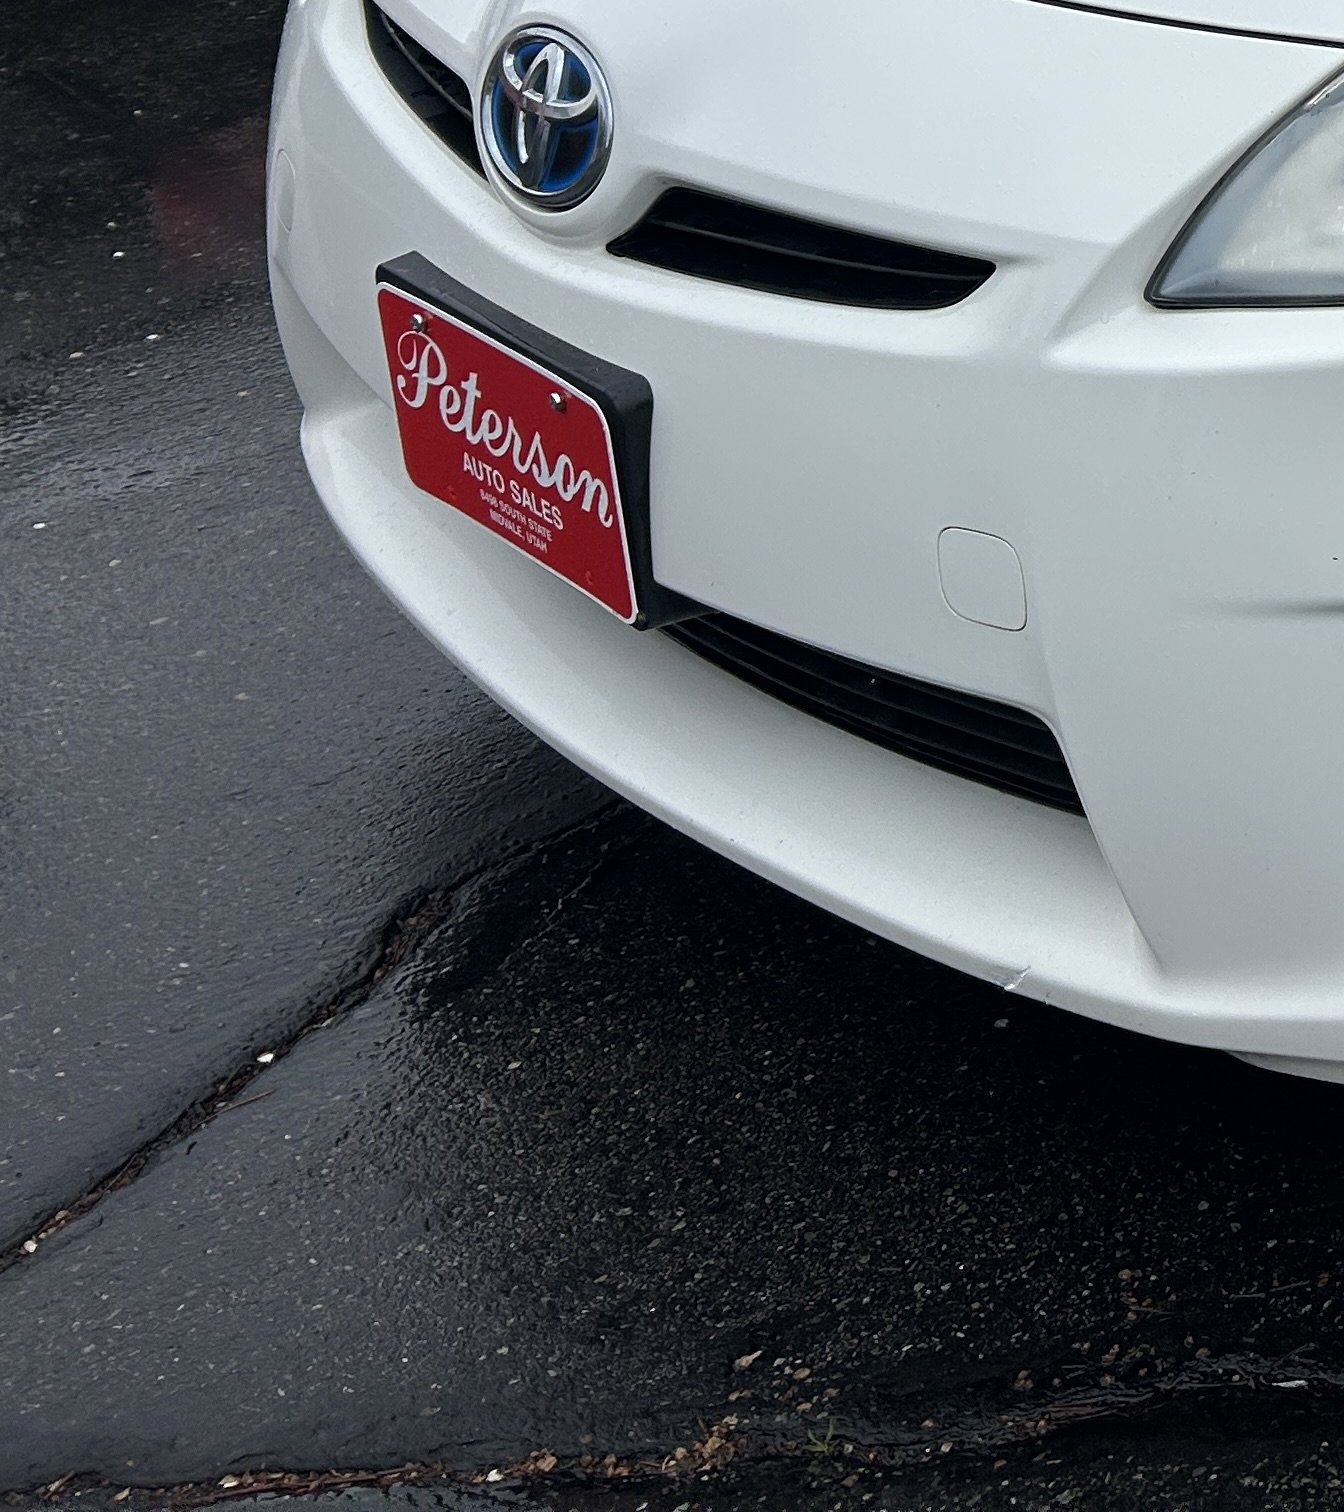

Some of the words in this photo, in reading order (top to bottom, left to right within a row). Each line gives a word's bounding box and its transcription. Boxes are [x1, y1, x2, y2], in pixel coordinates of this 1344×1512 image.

[396, 330, 614, 528] Peterson
[463, 451, 505, 494] AUTO
[509, 480, 563, 530] SALES
[499, 500, 527, 524] SOUTH
[527, 517, 553, 541] STATE
